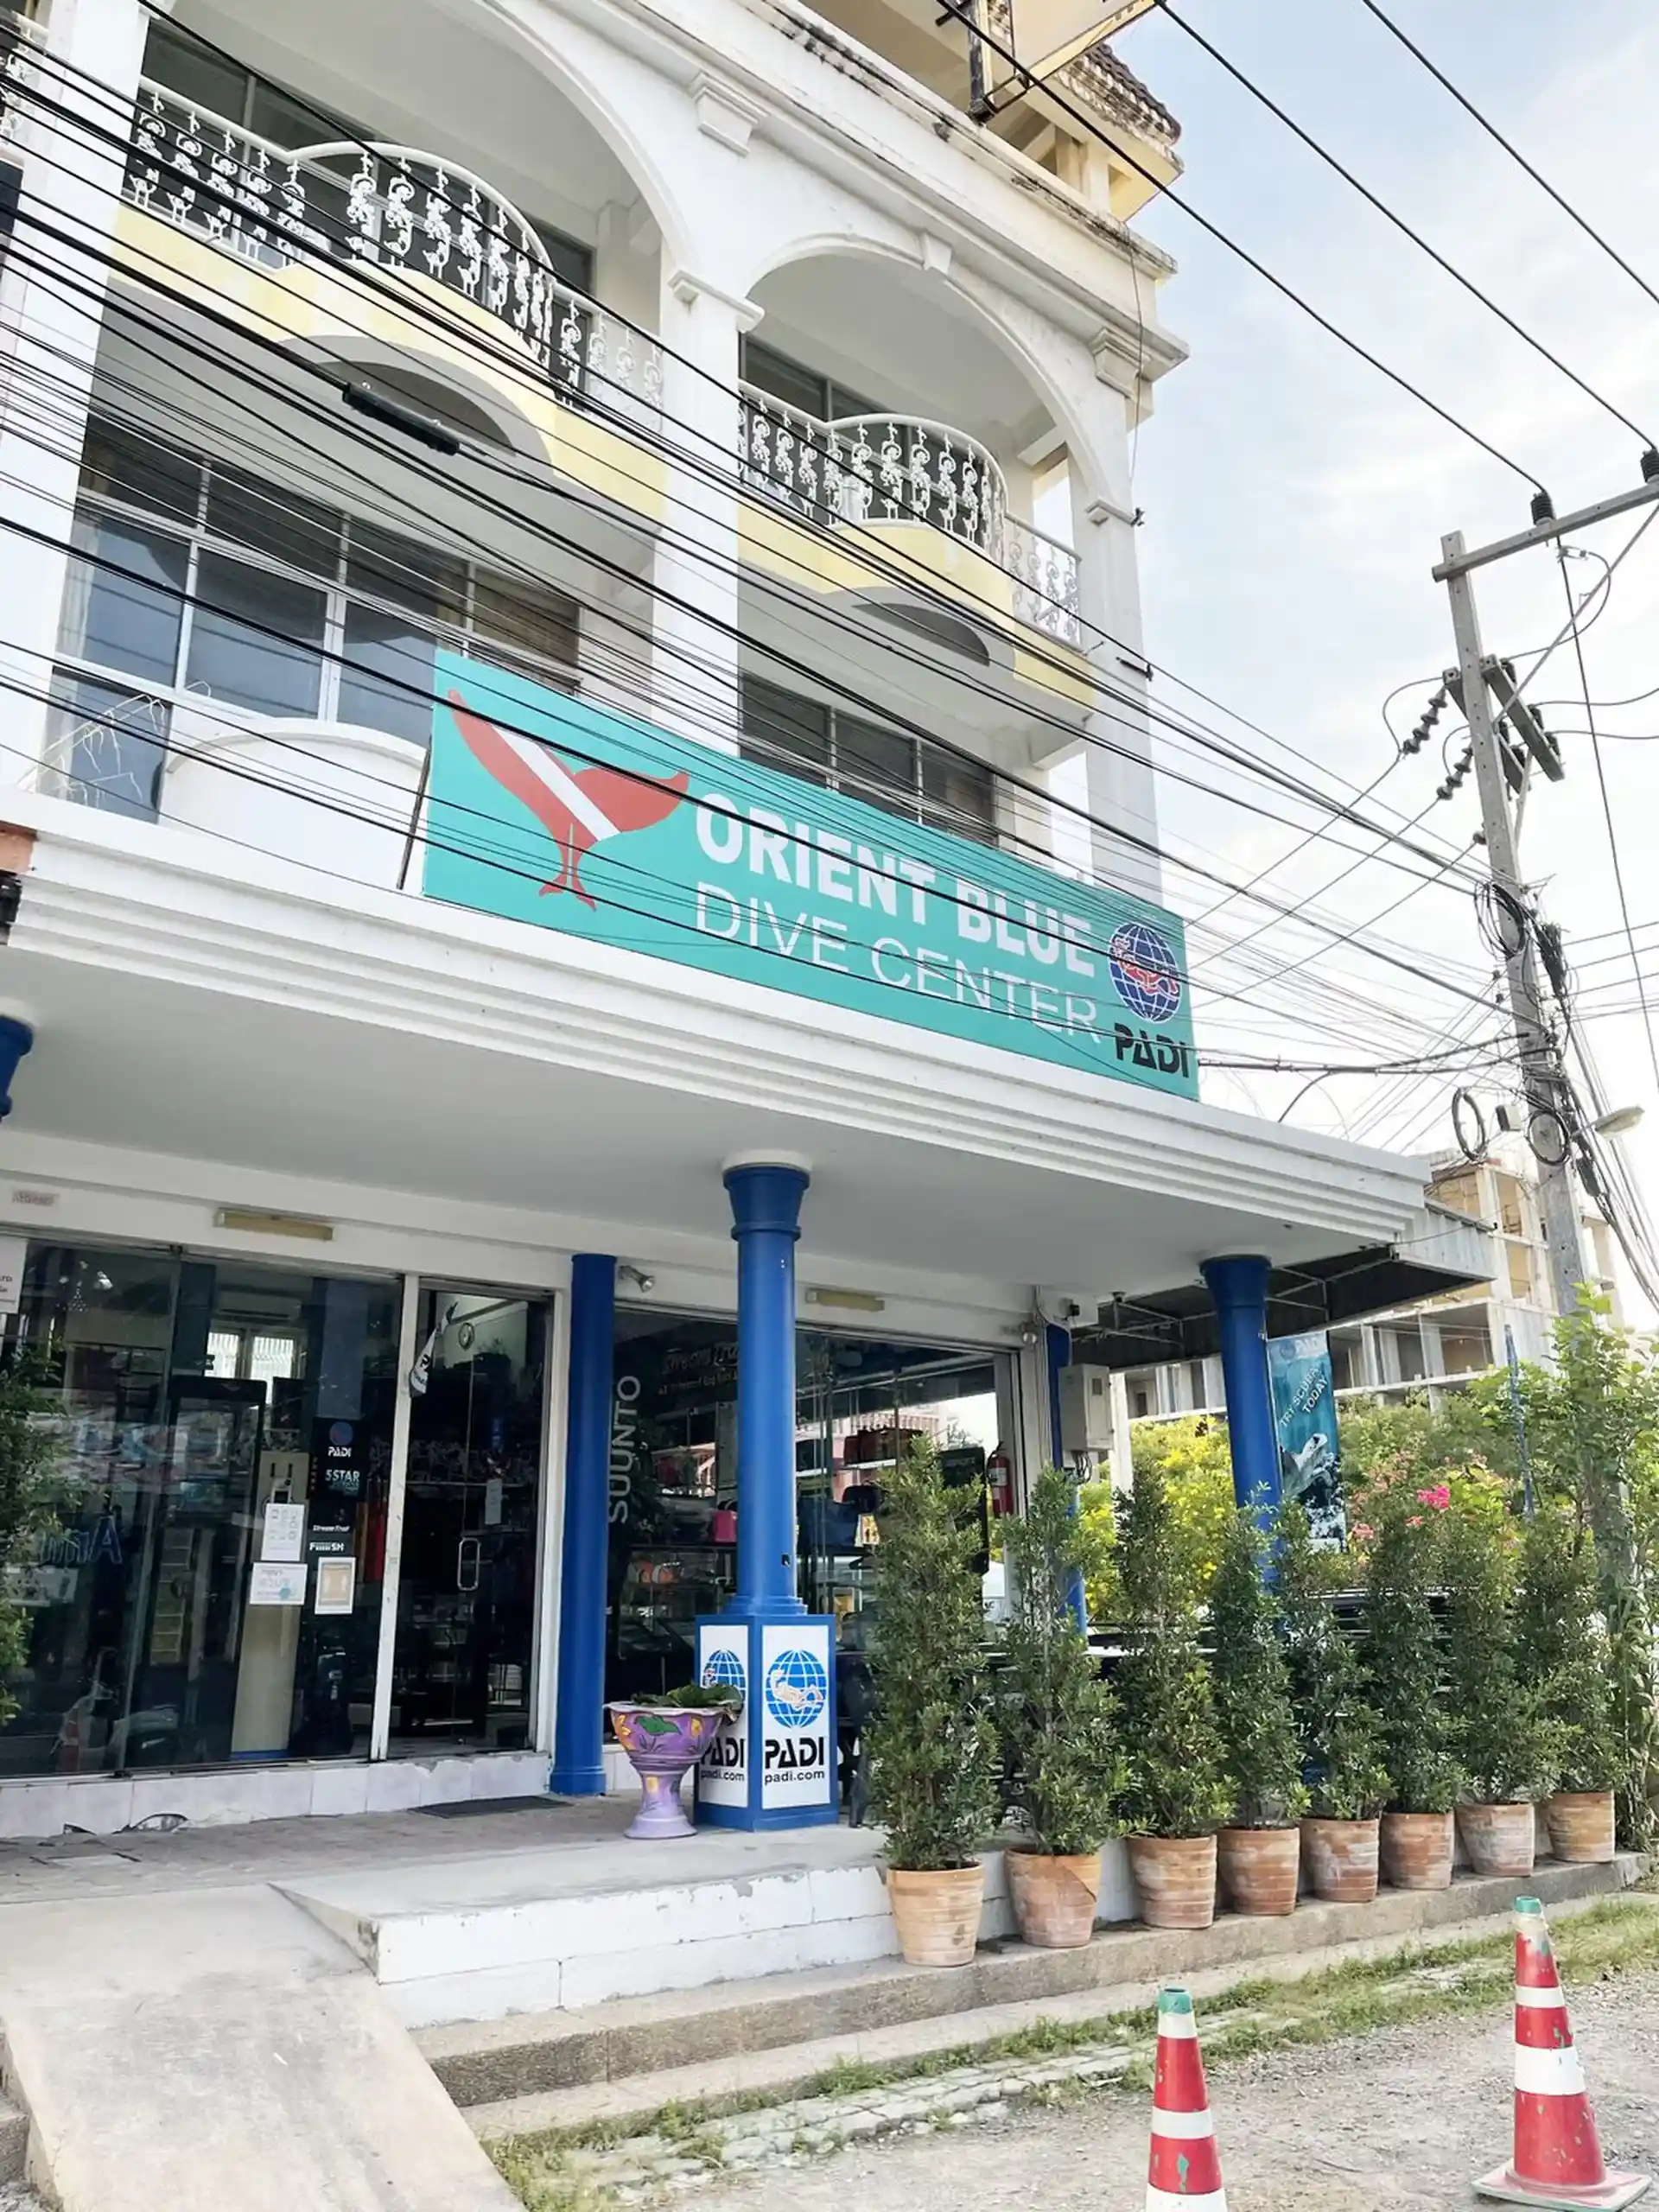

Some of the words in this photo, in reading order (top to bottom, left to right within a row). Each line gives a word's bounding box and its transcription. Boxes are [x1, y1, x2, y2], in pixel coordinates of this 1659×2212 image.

[696, 792, 936, 925] ORIENT
[955, 877, 1096, 978] BLUE
[696, 880, 850, 973] DIVE
[871, 937, 1103, 1044] CENTER
[1114, 1022, 1190, 1078] PADI
[1280, 1403, 1299, 1428] TRY
[1292, 1364, 1323, 1407] SCUBA
[1301, 1376, 1329, 1414] TODAY
[327, 1446, 353, 1459] PADI
[608, 1376, 641, 1525] SUUNTO
[764, 1736, 824, 1770] PADI
[764, 1770, 825, 1786] padi.com
